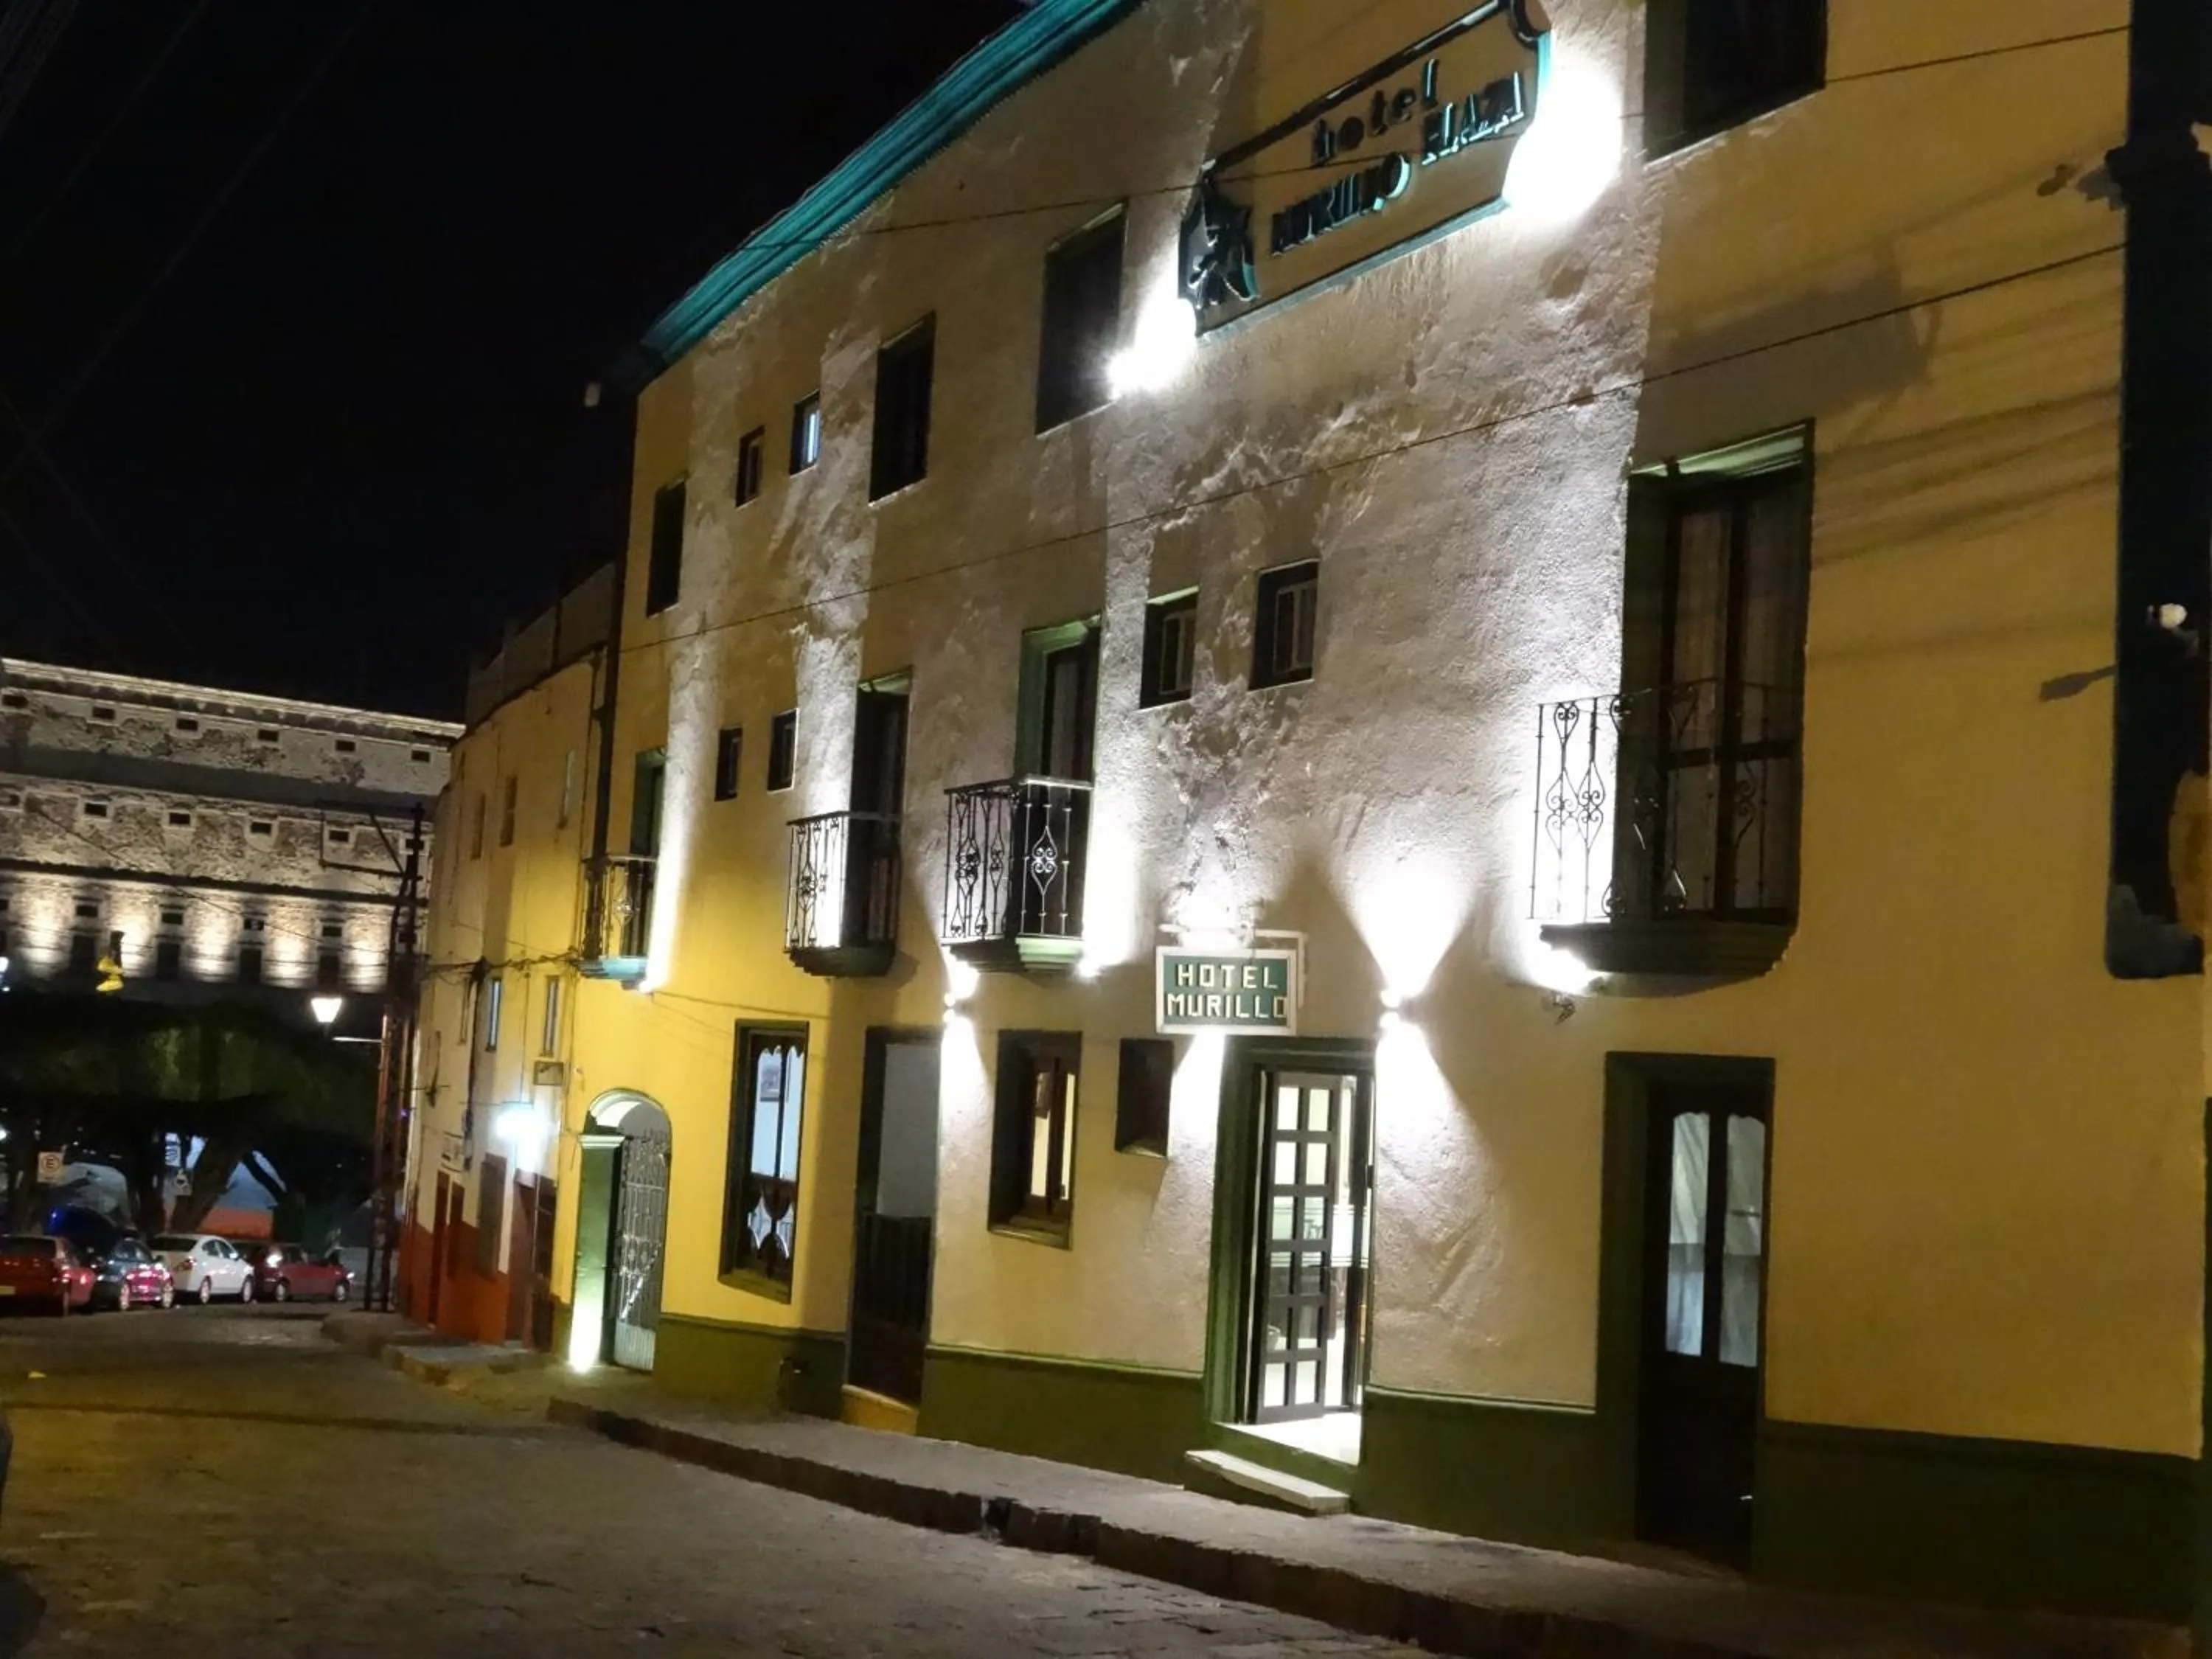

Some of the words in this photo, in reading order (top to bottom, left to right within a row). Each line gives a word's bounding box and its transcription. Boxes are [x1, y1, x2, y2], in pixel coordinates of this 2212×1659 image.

[1312, 59, 1440, 166] hotel
[1177, 965, 1277, 989] HOTEL
[1166, 994, 1287, 1018] MURILLO
